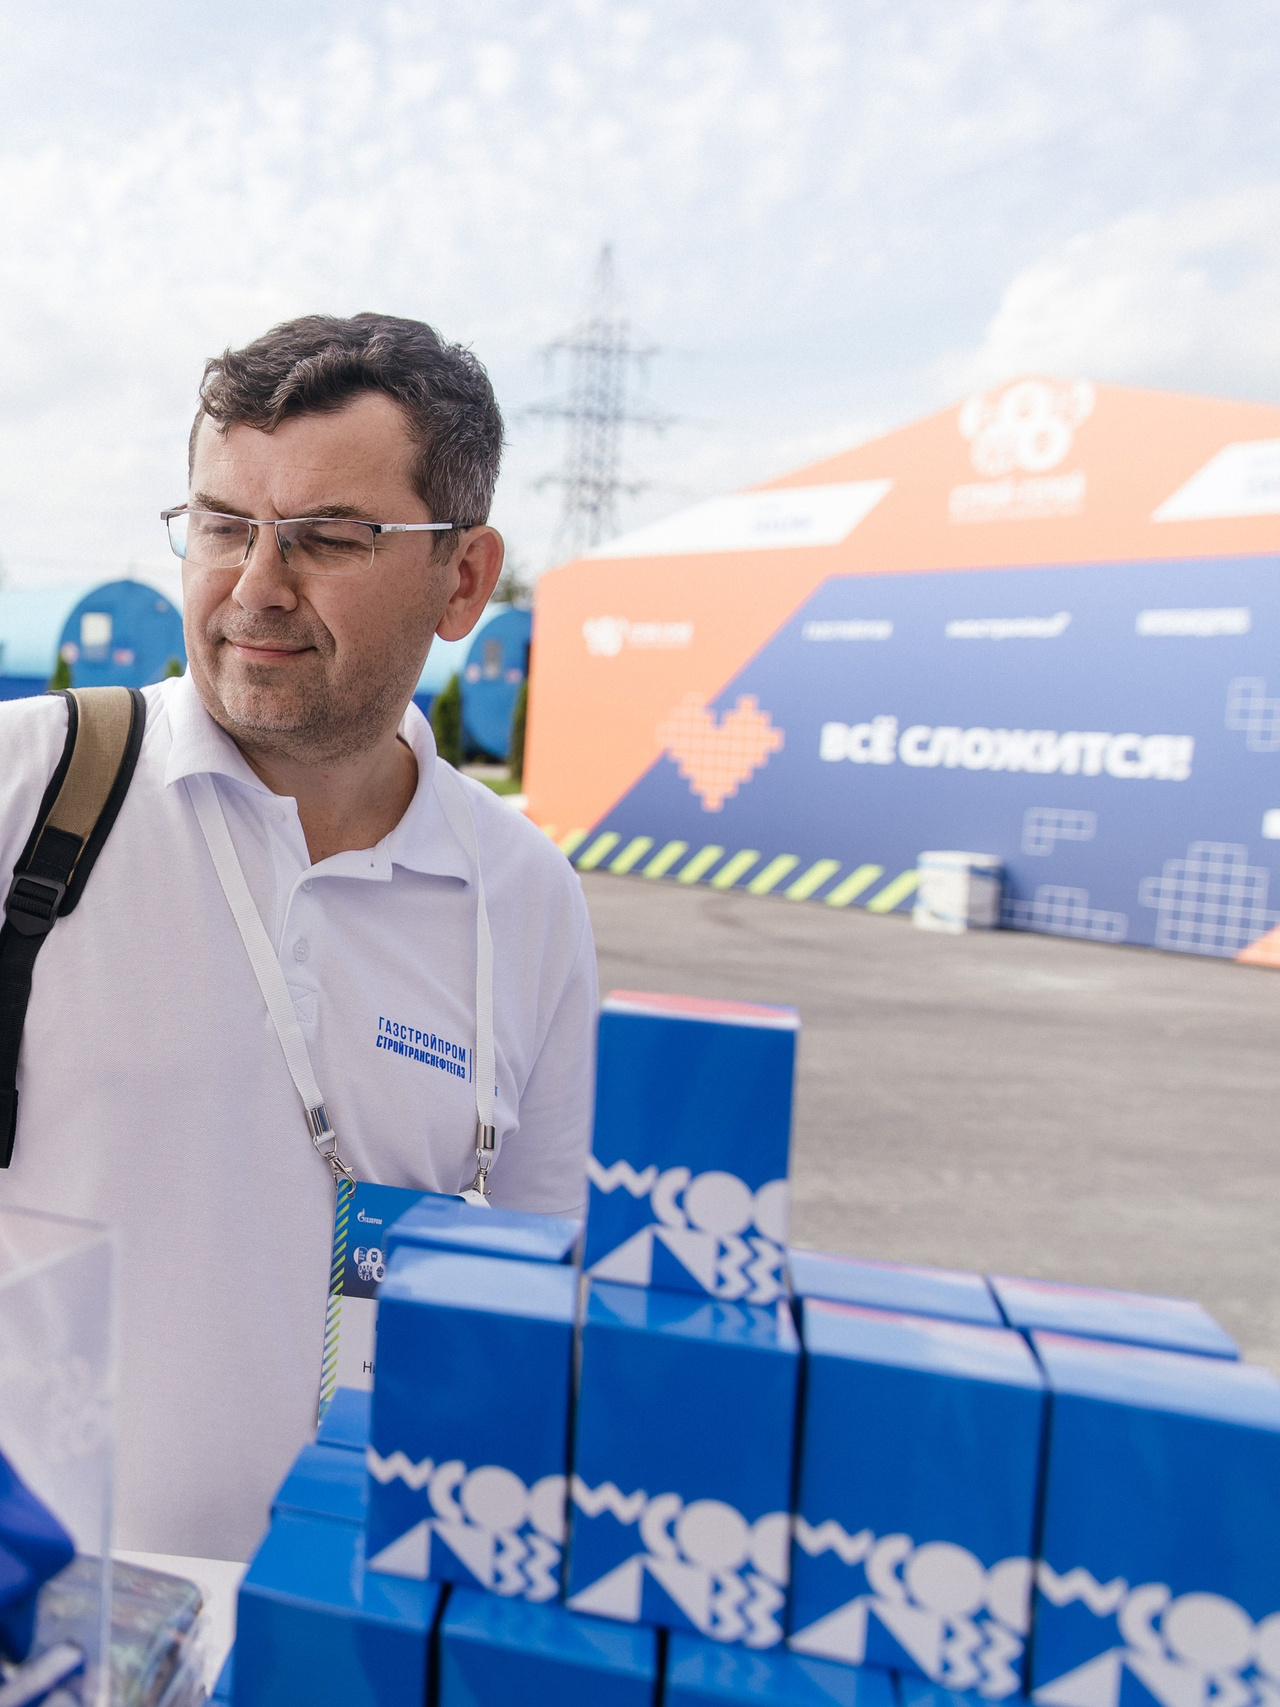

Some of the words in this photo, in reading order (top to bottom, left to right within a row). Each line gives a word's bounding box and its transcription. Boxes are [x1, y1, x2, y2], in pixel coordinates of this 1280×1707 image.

[819, 714, 898, 765] ВСЁ
[898, 723, 1195, 782] СЛОЖИТСЯ!
[376, 1034, 466, 1079] СТРОЙТРАНСНЕФТЕГАЗ
[378, 1016, 466, 1063] ГАЗСТРОЙПРОМ
